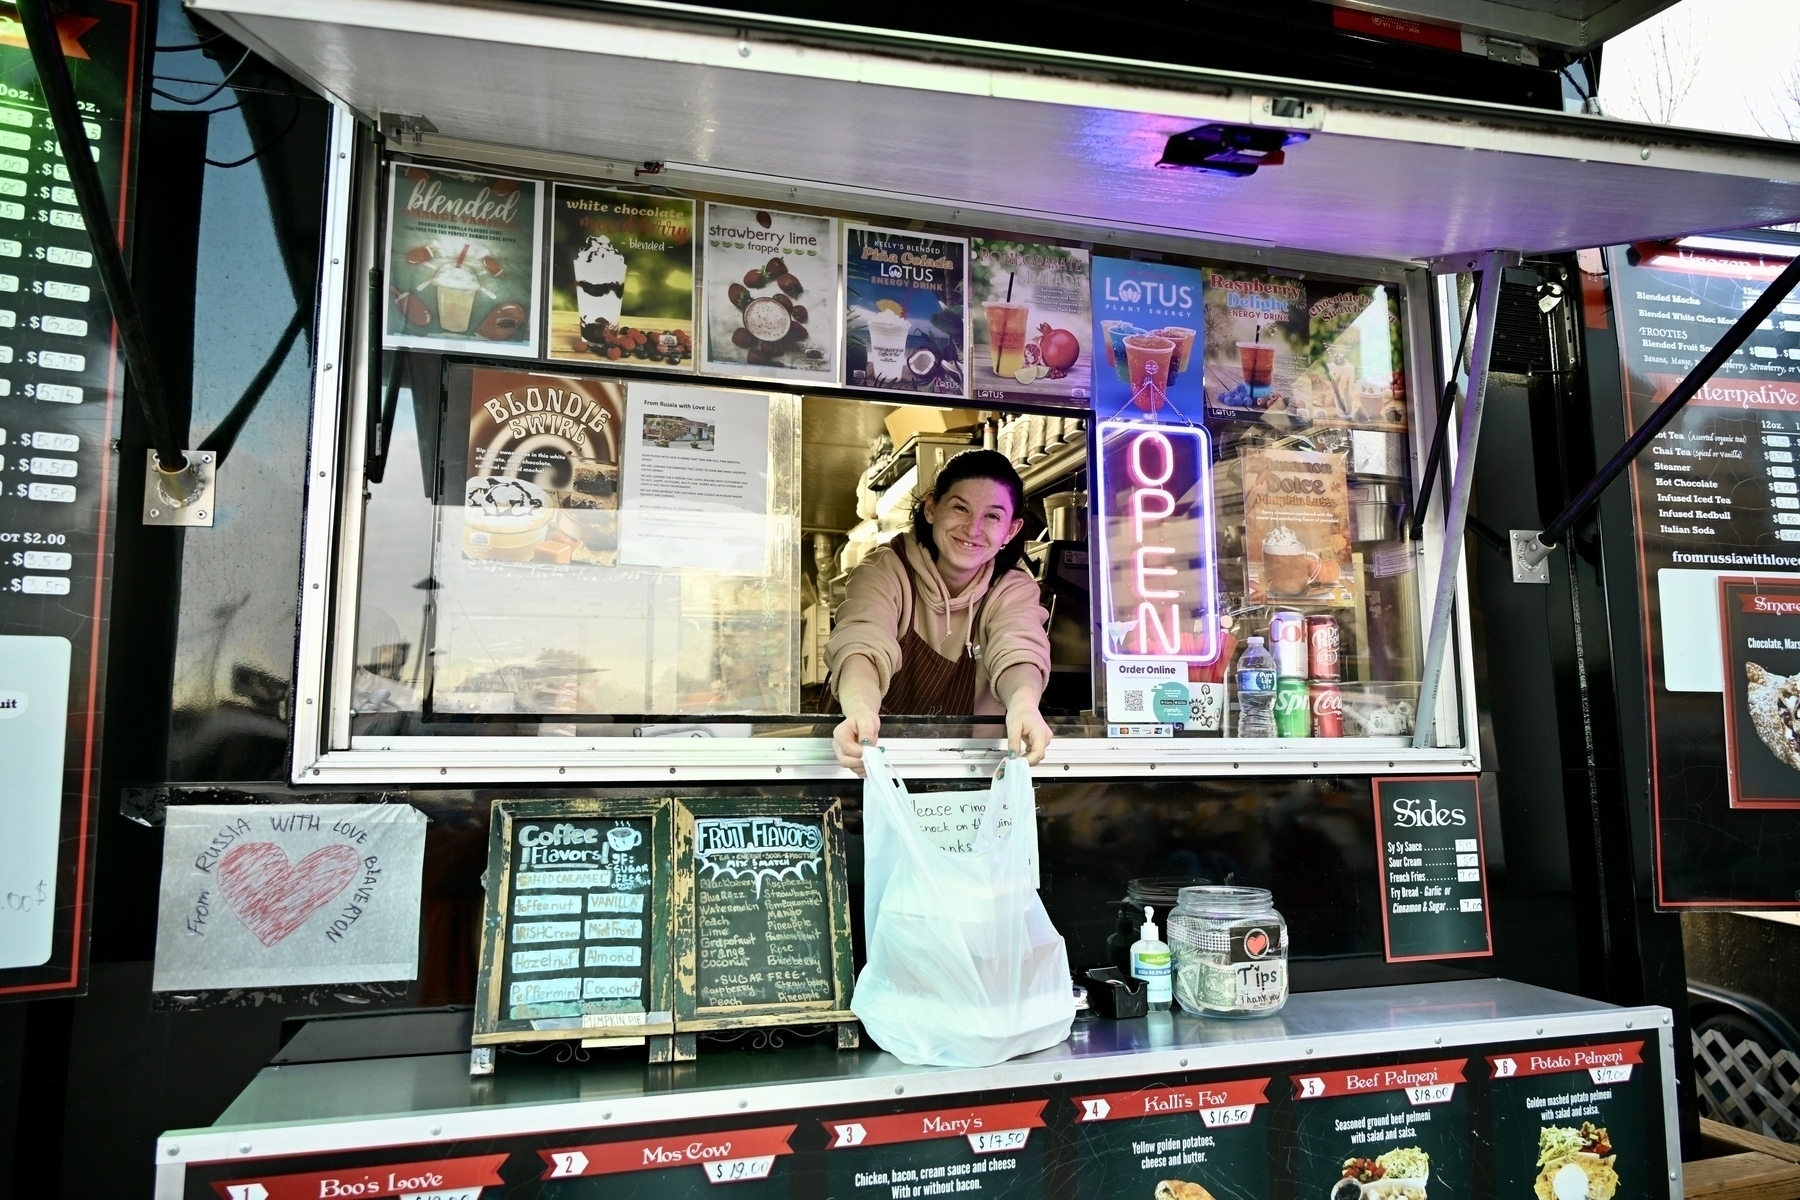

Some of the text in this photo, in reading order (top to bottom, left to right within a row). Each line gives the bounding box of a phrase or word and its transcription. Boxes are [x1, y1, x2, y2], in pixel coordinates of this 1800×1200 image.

[407, 176, 521, 223] blended
[566, 199, 684, 219] white chocolate
[709, 224, 817, 246] strawberry lime
[629, 237, 664, 251] blended
[748, 241, 780, 255] frappe
[874, 240, 941, 255] KELLY'S BLENDED
[861, 246, 954, 271] Piña Colada
[980, 247, 1083, 272] POMEGRANATE
[881, 262, 934, 282] LOTUS
[871, 275, 943, 292] ENERGY DRINK
[1210, 274, 1300, 299] Raspberry
[1105, 277, 1193, 309] LOTUS
[1636, 291, 1701, 305] Blended Mocha
[1105, 304, 1192, 317] PLANT ENERGY
[1227, 293, 1290, 312] Delight
[1309, 293, 1360, 317] Chocolate
[1228, 309, 1289, 322] ENERGY DRINK
[1638, 309, 1716, 324] Blended White Choc
[1639, 326, 1688, 339] FROOTIES
[1642, 339, 1676, 350] Blended
[1678, 342, 1698, 352] Fruit
[978, 390, 1004, 399] LOTUS
[483, 387, 612, 433] BLONDIE
[1212, 408, 1236, 417] LOTUS
[509, 413, 588, 445] SWIRL
[1761, 420, 1785, 430] 12oz.
[1668, 431, 1684, 440] Tea
[1652, 447, 1691, 457] Chai Tea
[1654, 463, 1691, 472] Steamer
[1266, 474, 1326, 494] Dolce
[1655, 478, 1718, 489] Hot Chocolate
[1657, 494, 1731, 505] Infused Iced Tea
[1658, 509, 1731, 520] Infused Redbull
[1660, 525, 1715, 535] Italian Soda
[23, 532, 66, 546] $2.00
[1131, 431, 1183, 655] OPEN
[1747, 637, 1783, 650] Chocolate,
[1119, 665, 1176, 674] Order Online
[1393, 798, 1467, 828] Sides
[518, 823, 599, 847] Coffee
[699, 822, 750, 852] FRUIT
[1387, 841, 1422, 854] Sy Sy Sauce
[726, 859, 790, 868] MIX MATCH
[1388, 856, 1423, 868] Sour Cream
[187, 813, 381, 943] From RUSSIA WITH LOVE BEAVERTON
[557, 873, 607, 884] CARAMEL
[1389, 871, 1426, 883] French Fries
[1391, 885, 1451, 900] Fry Bread Garlic or
[590, 895, 638, 908] VANILLA
[1392, 901, 1447, 914] Cinnamon & Sugar
[700, 916, 730, 927] Peach
[767, 918, 812, 931] Pineapple
[701, 928, 730, 937] Lime
[700, 933, 757, 949] Grapefruit
[515, 950, 573, 969] Hazelnut
[586, 949, 634, 964] Almond
[767, 970, 801, 982] FREE
[1237, 964, 1277, 990] Tips
[585, 980, 640, 996] Coconut
[1239, 992, 1281, 1005] Thank you
[583, 1014, 642, 1026] PUMPKIN PIE
[1530, 1048, 1623, 1071] Potato Pelmeni
[1346, 1067, 1438, 1090] Beef Pelmeni
[1198, 1090, 1228, 1107] Fav
[1414, 1086, 1449, 1102] $18.00
[1526, 1088, 1612, 1109] Golden mashed potato pelmeni
[923, 1113, 983, 1136] Mary's
[1210, 1109, 1248, 1125] $16.50
[1334, 1108, 1431, 1131] Seasoned ground beef pelmeni
[979, 1132, 1025, 1149] $17.50
[1132, 1135, 1216, 1155] Yellow golden potatoes,
[642, 1142, 732, 1165] Mos Cow
[1141, 1150, 1208, 1170] cheese and butter.
[855, 1157, 1016, 1187] Chicken, bacon, cream sauce and cheese
[319, 1172, 444, 1199] Boo's Love
[891, 1177, 982, 1200] With or without bacon.
